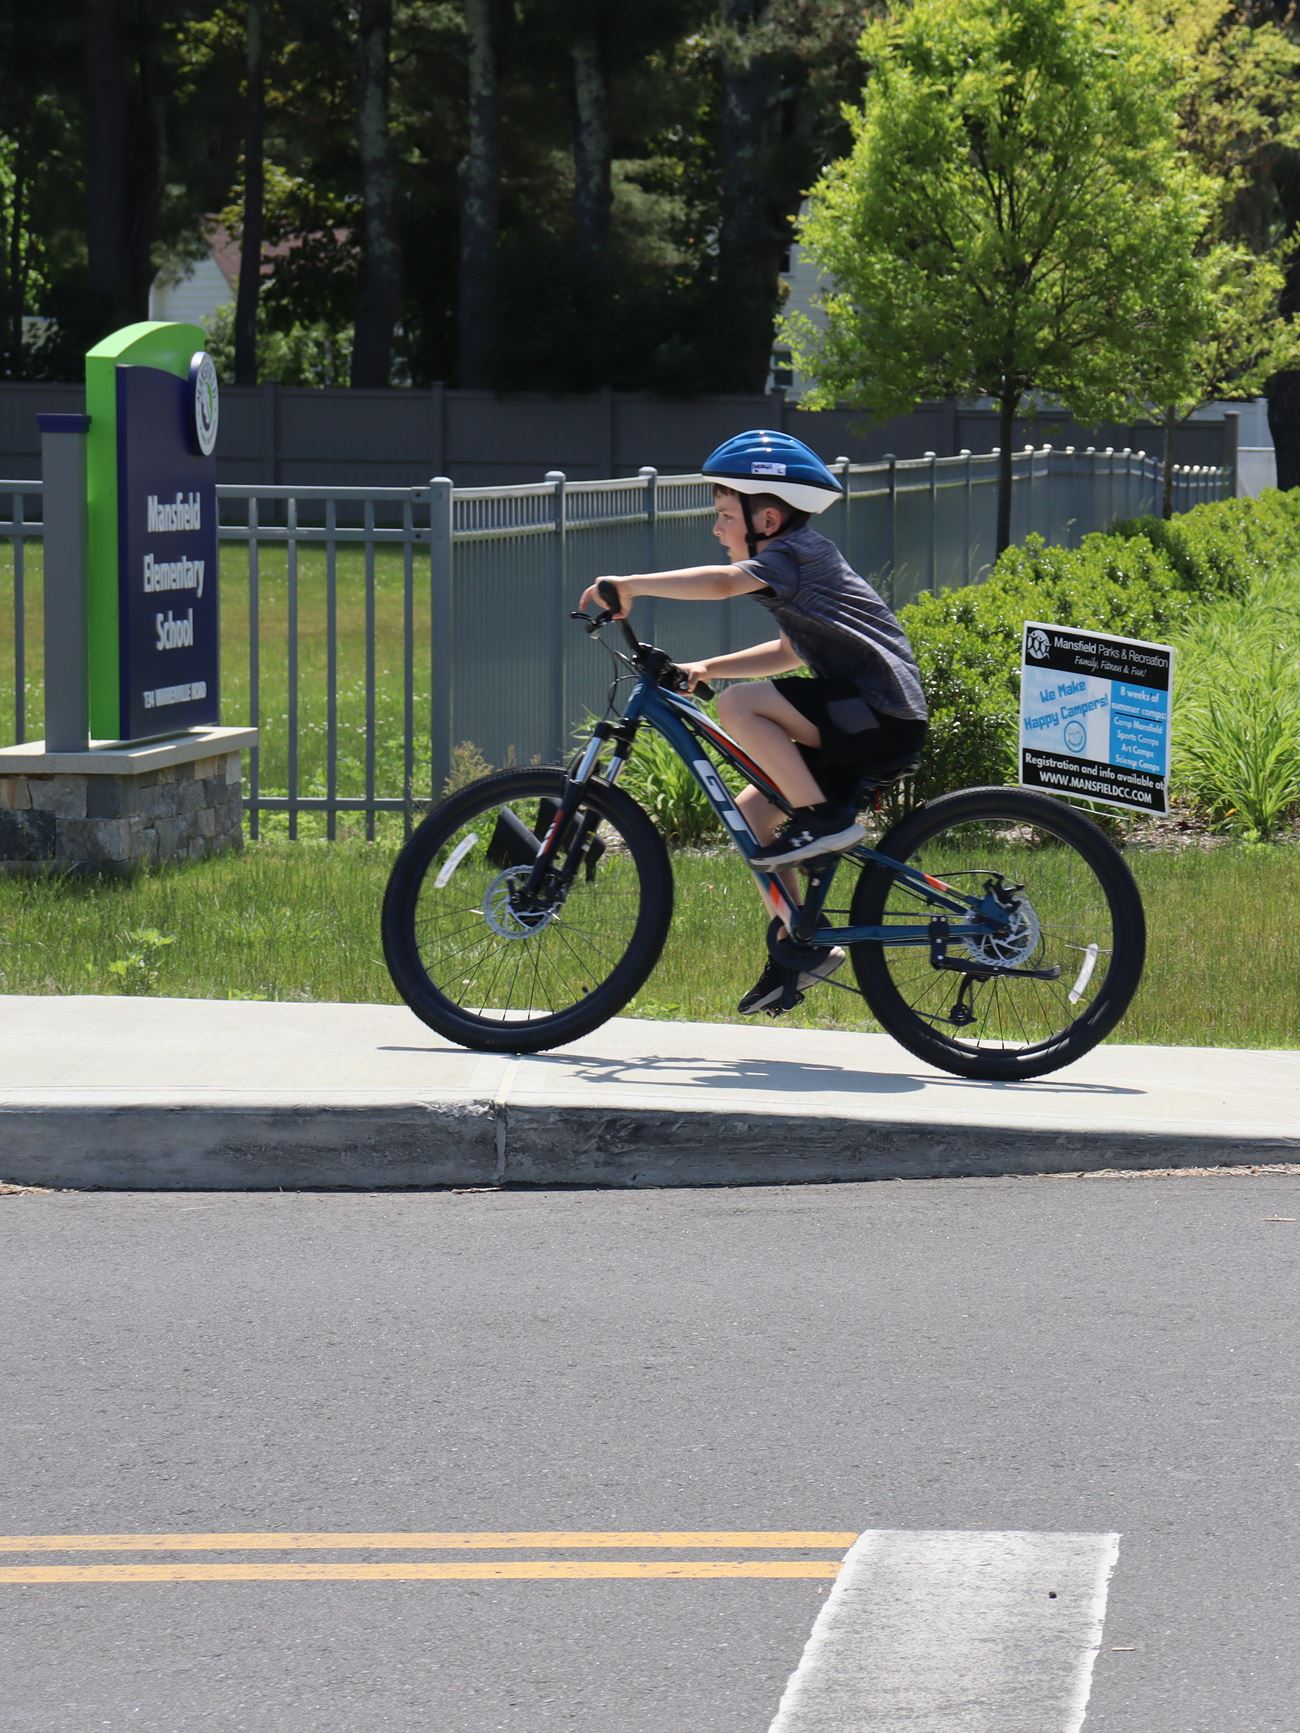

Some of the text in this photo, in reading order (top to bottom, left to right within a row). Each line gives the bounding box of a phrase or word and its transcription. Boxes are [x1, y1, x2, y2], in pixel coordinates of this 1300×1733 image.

[147, 491, 201, 533] Mansfield
[143, 553, 205, 599] Elementary
[156, 607, 194, 650] School
[1054, 636, 1169, 668] Mansfield Parks & Recreation
[1123, 665, 1130, 674] &
[1039, 680, 1087, 704] We Make
[1120, 686, 1160, 704] 8 weeks of
[1024, 694, 1110, 731] Happy Campers!
[1111, 702, 1140, 716] summer
[1113, 717, 1163, 735] Camp Mansfield
[1116, 729, 1160, 748] Sports Camps
[1121, 742, 1154, 759] Art Camps
[1025, 753, 1165, 791] Registration and info available at
[1115, 754, 1160, 773] Science Camps
[1039, 770, 1153, 804] WWW.MANSFIELDCC.COM
